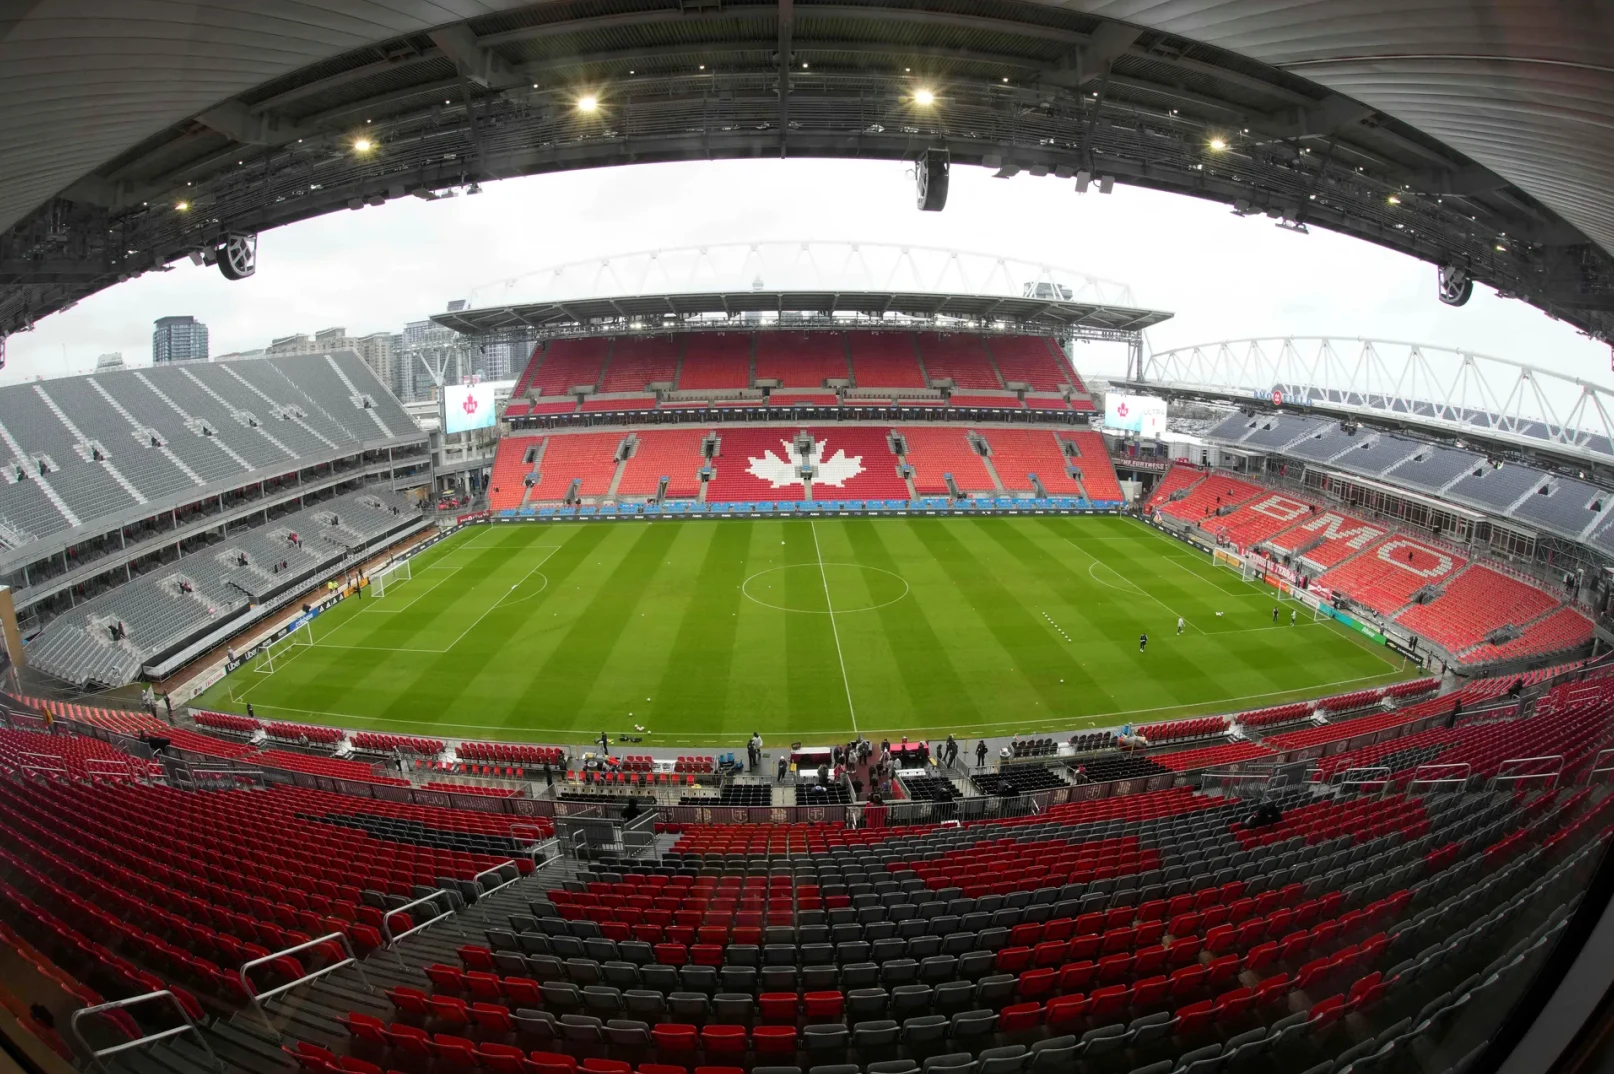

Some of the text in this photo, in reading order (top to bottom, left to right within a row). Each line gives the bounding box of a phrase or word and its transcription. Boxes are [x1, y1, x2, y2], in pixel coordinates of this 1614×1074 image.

[1254, 390, 1272, 401] BMO
[1250, 495, 1453, 578] BMO
[244, 648, 257, 661] Uber
[227, 659, 241, 672] Uber
